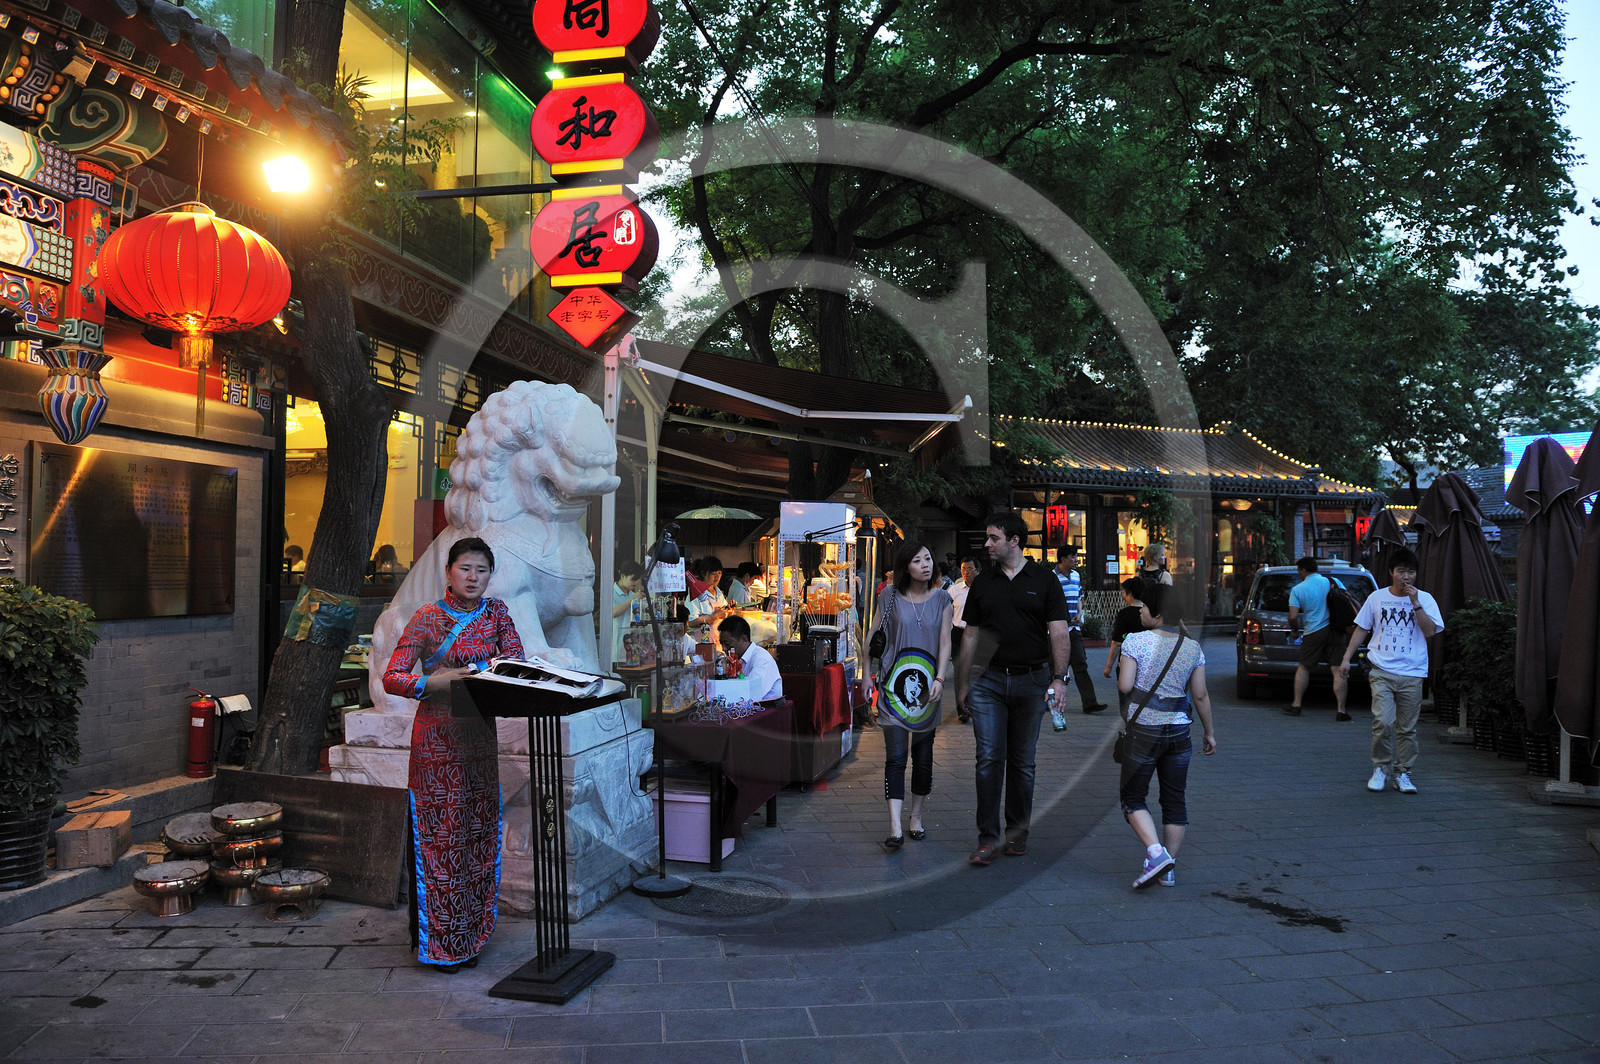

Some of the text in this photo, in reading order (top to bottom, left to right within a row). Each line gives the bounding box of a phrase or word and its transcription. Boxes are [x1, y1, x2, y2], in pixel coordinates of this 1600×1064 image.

[569, 295, 602, 307] 中华
[560, 309, 611, 324] 老字号
